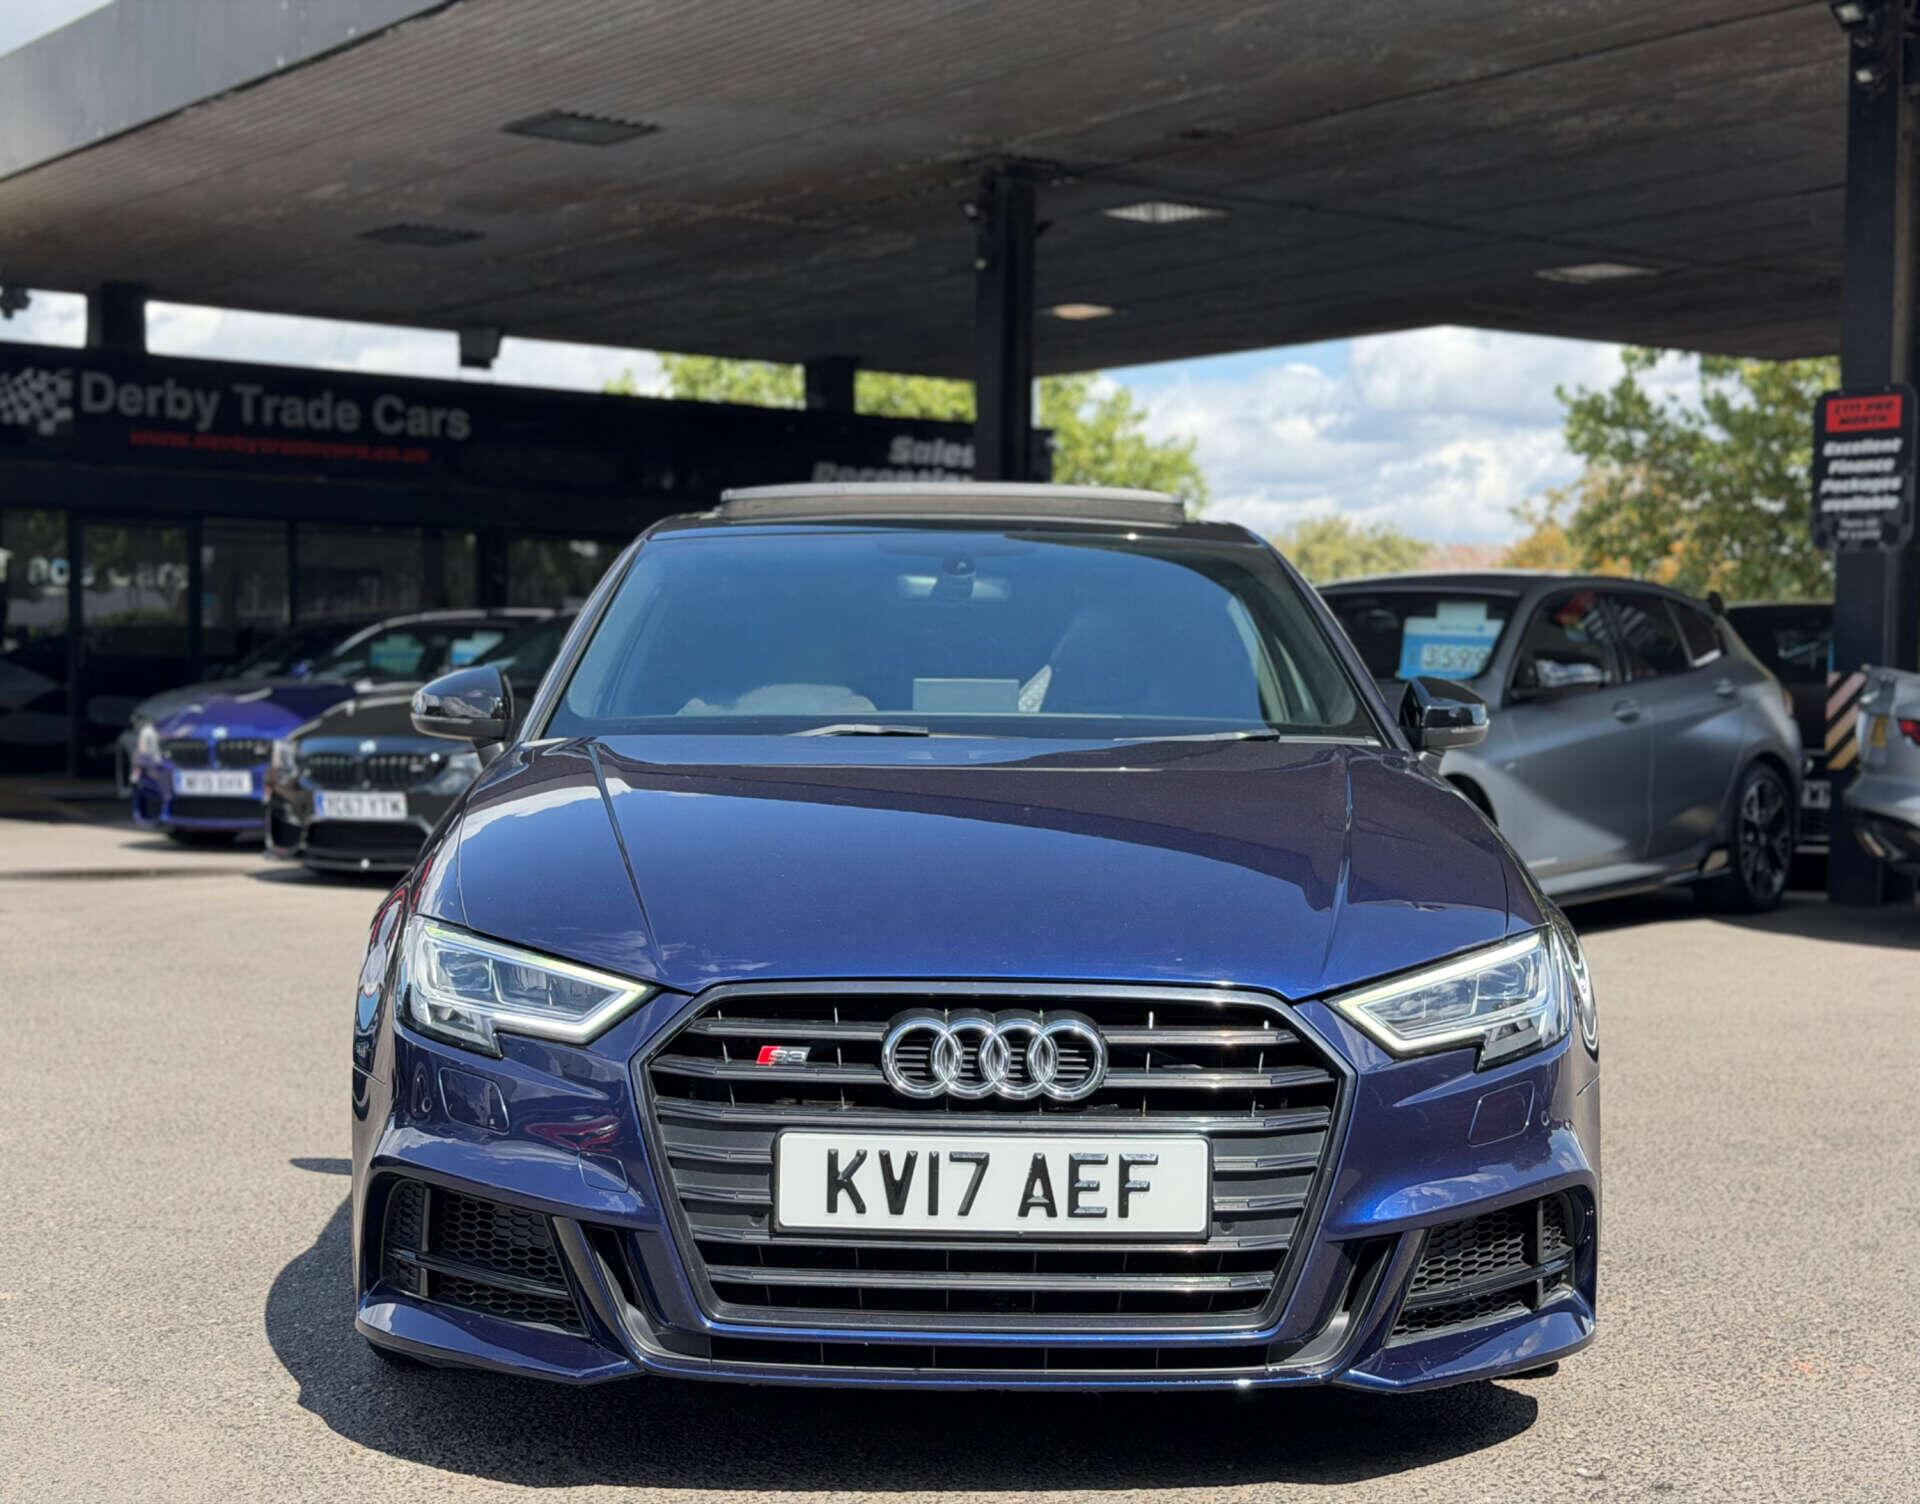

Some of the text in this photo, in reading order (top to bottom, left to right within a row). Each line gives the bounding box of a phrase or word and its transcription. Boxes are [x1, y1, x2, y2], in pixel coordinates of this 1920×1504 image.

[81, 371, 470, 440] Derby Trade Cars
[889, 435, 976, 469] Sales
[825, 1148, 1159, 1219] KV17 AEF
